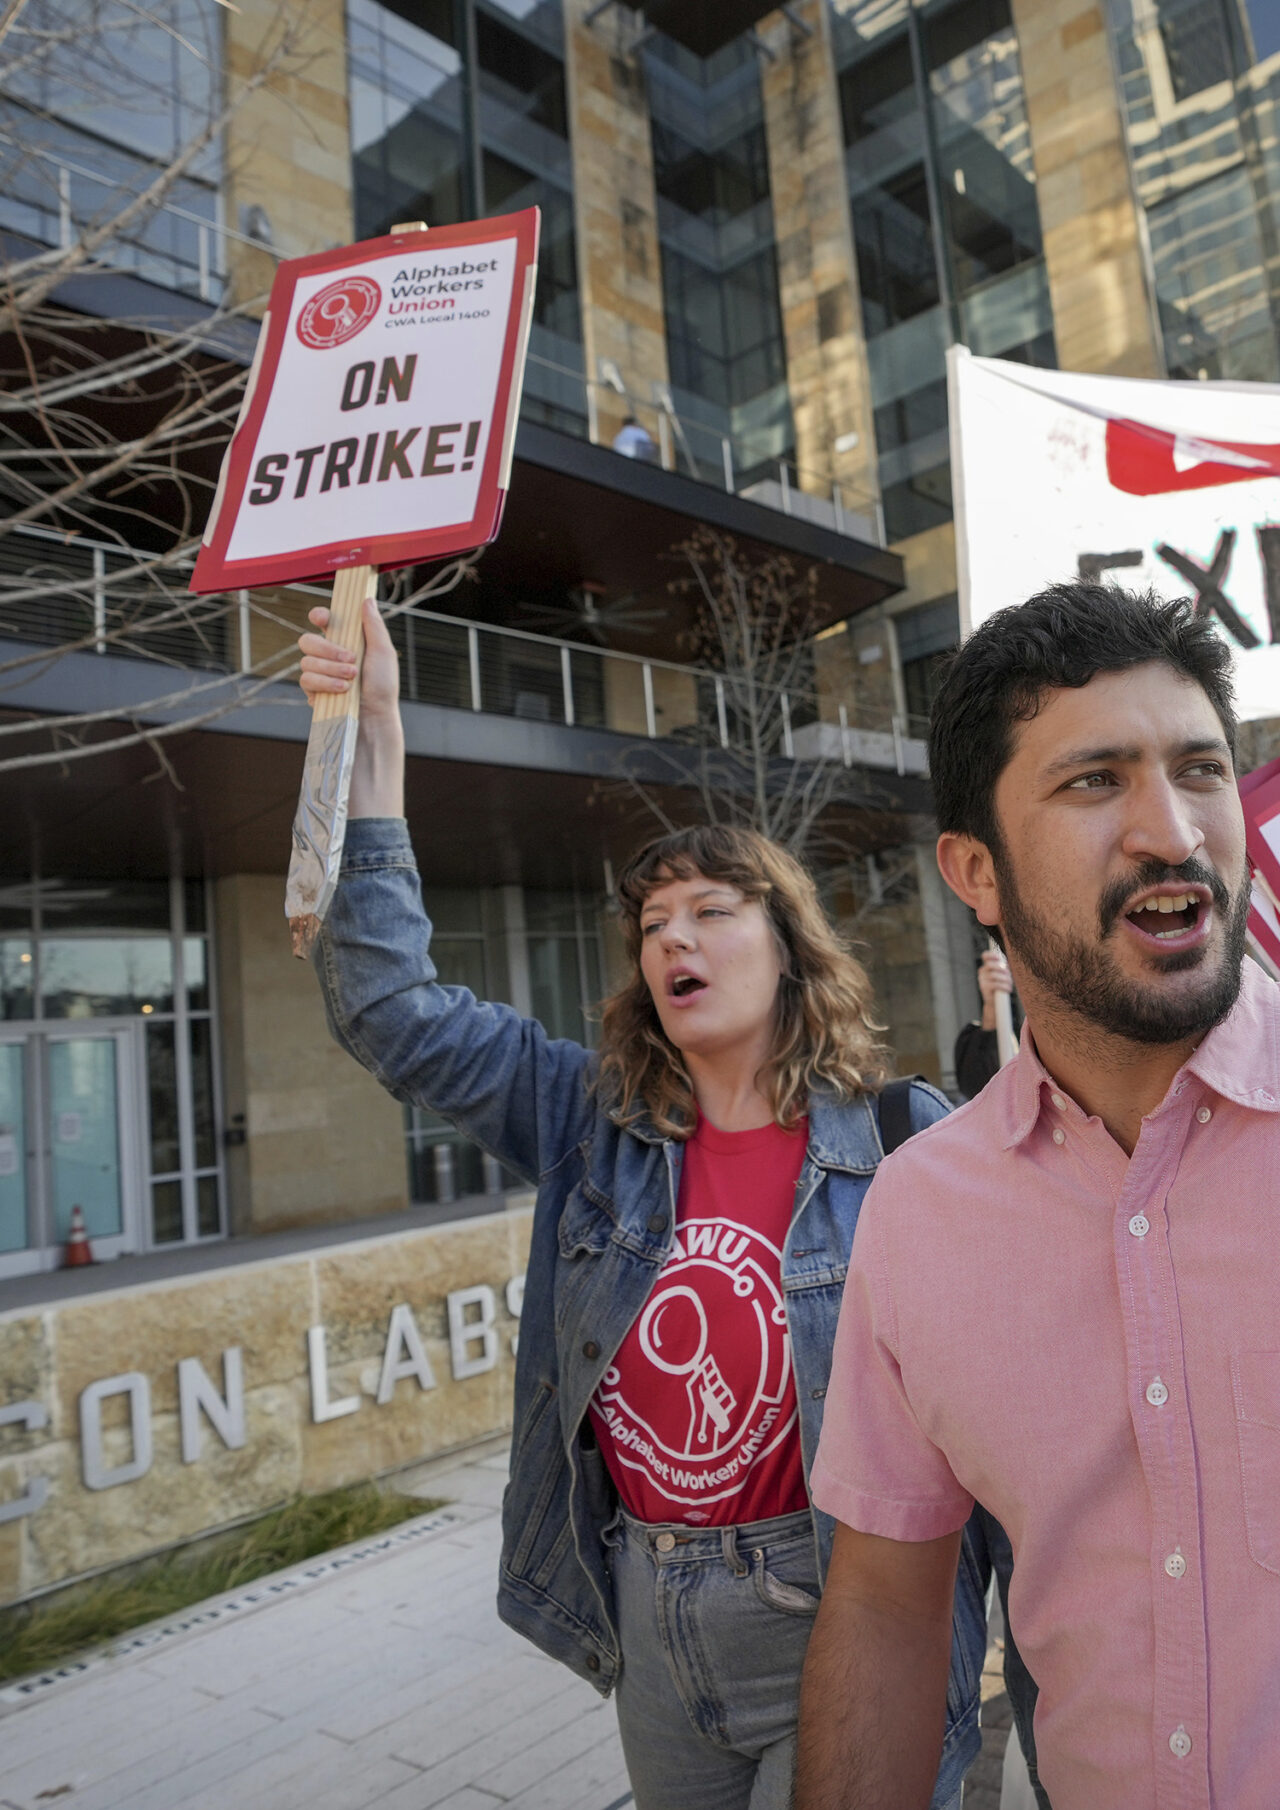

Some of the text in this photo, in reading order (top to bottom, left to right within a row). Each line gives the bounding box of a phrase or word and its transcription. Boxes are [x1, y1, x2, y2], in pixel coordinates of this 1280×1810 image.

[393, 258, 498, 282] Alphabet
[391, 279, 484, 299] Workers
[388, 297, 455, 315] Union
[384, 309, 490, 329] CWA Local 1400
[340, 354, 418, 412] ON
[248, 420, 482, 506] STRIKE!
[602, 1405, 781, 1491] Alphabet Workers Union
